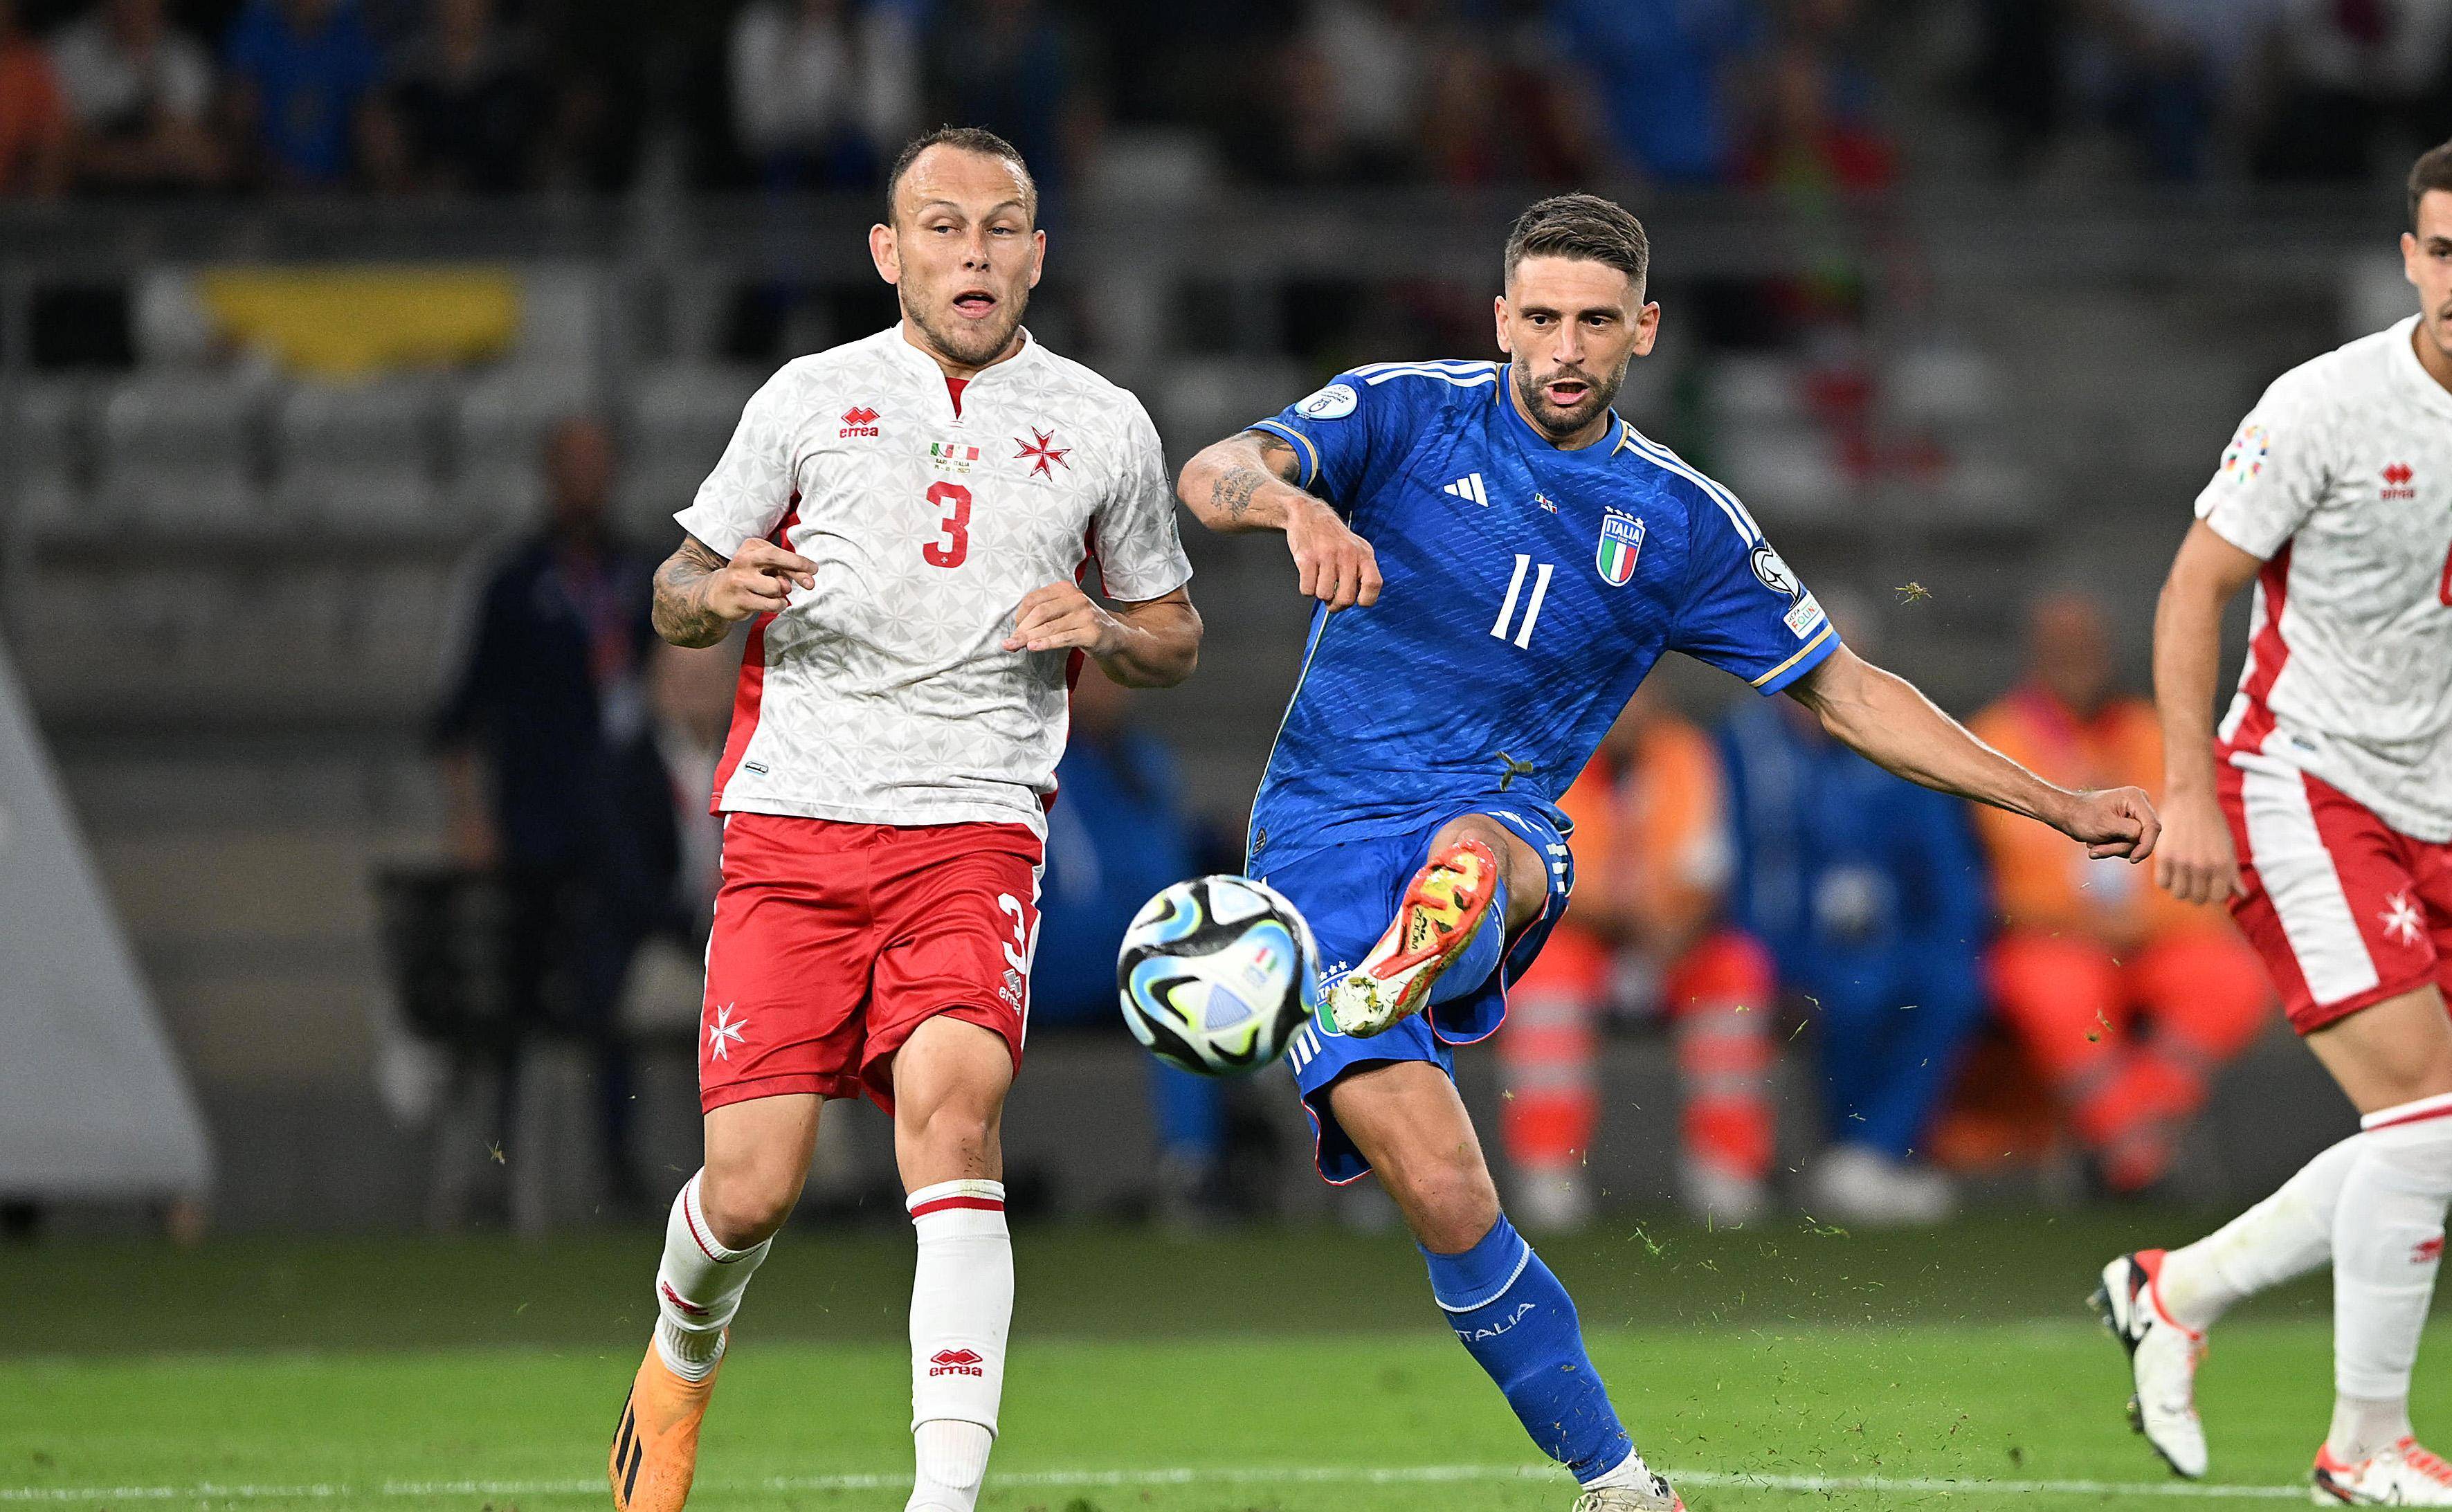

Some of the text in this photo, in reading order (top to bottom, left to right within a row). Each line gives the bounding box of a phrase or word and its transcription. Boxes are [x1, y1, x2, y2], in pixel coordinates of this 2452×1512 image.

[839, 427, 878, 438] errea
[923, 481, 972, 568] 3
[1606, 519, 1640, 543] ITALIA
[1489, 554, 1554, 650] 11
[997, 893, 1026, 975] 3
[1412, 907, 1422, 949] ZOOM
[1455, 1303, 1535, 1342] ITALIA
